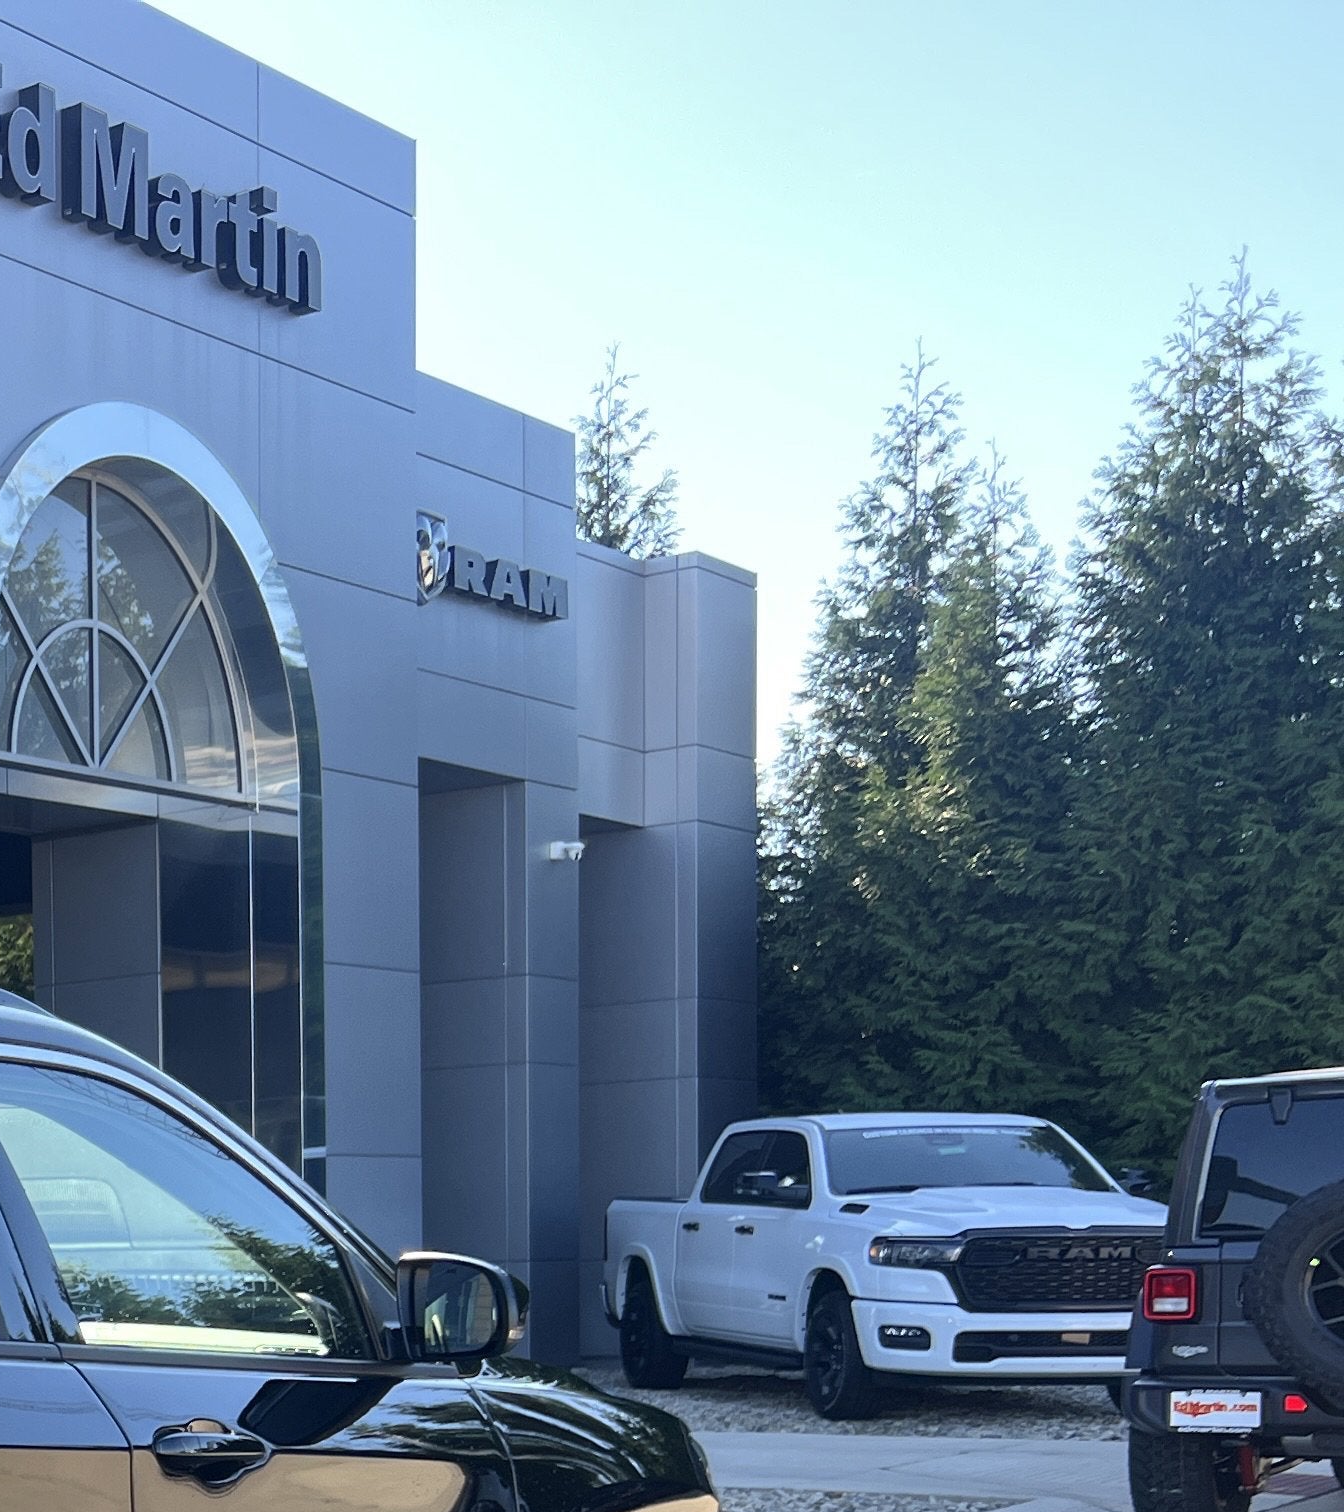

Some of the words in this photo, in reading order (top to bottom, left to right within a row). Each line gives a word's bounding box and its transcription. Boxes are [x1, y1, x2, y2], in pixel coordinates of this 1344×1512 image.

[60, 102, 323, 316] Martin
[446, 545, 569, 621] RAM
[1025, 1246, 1132, 1260] RAM
